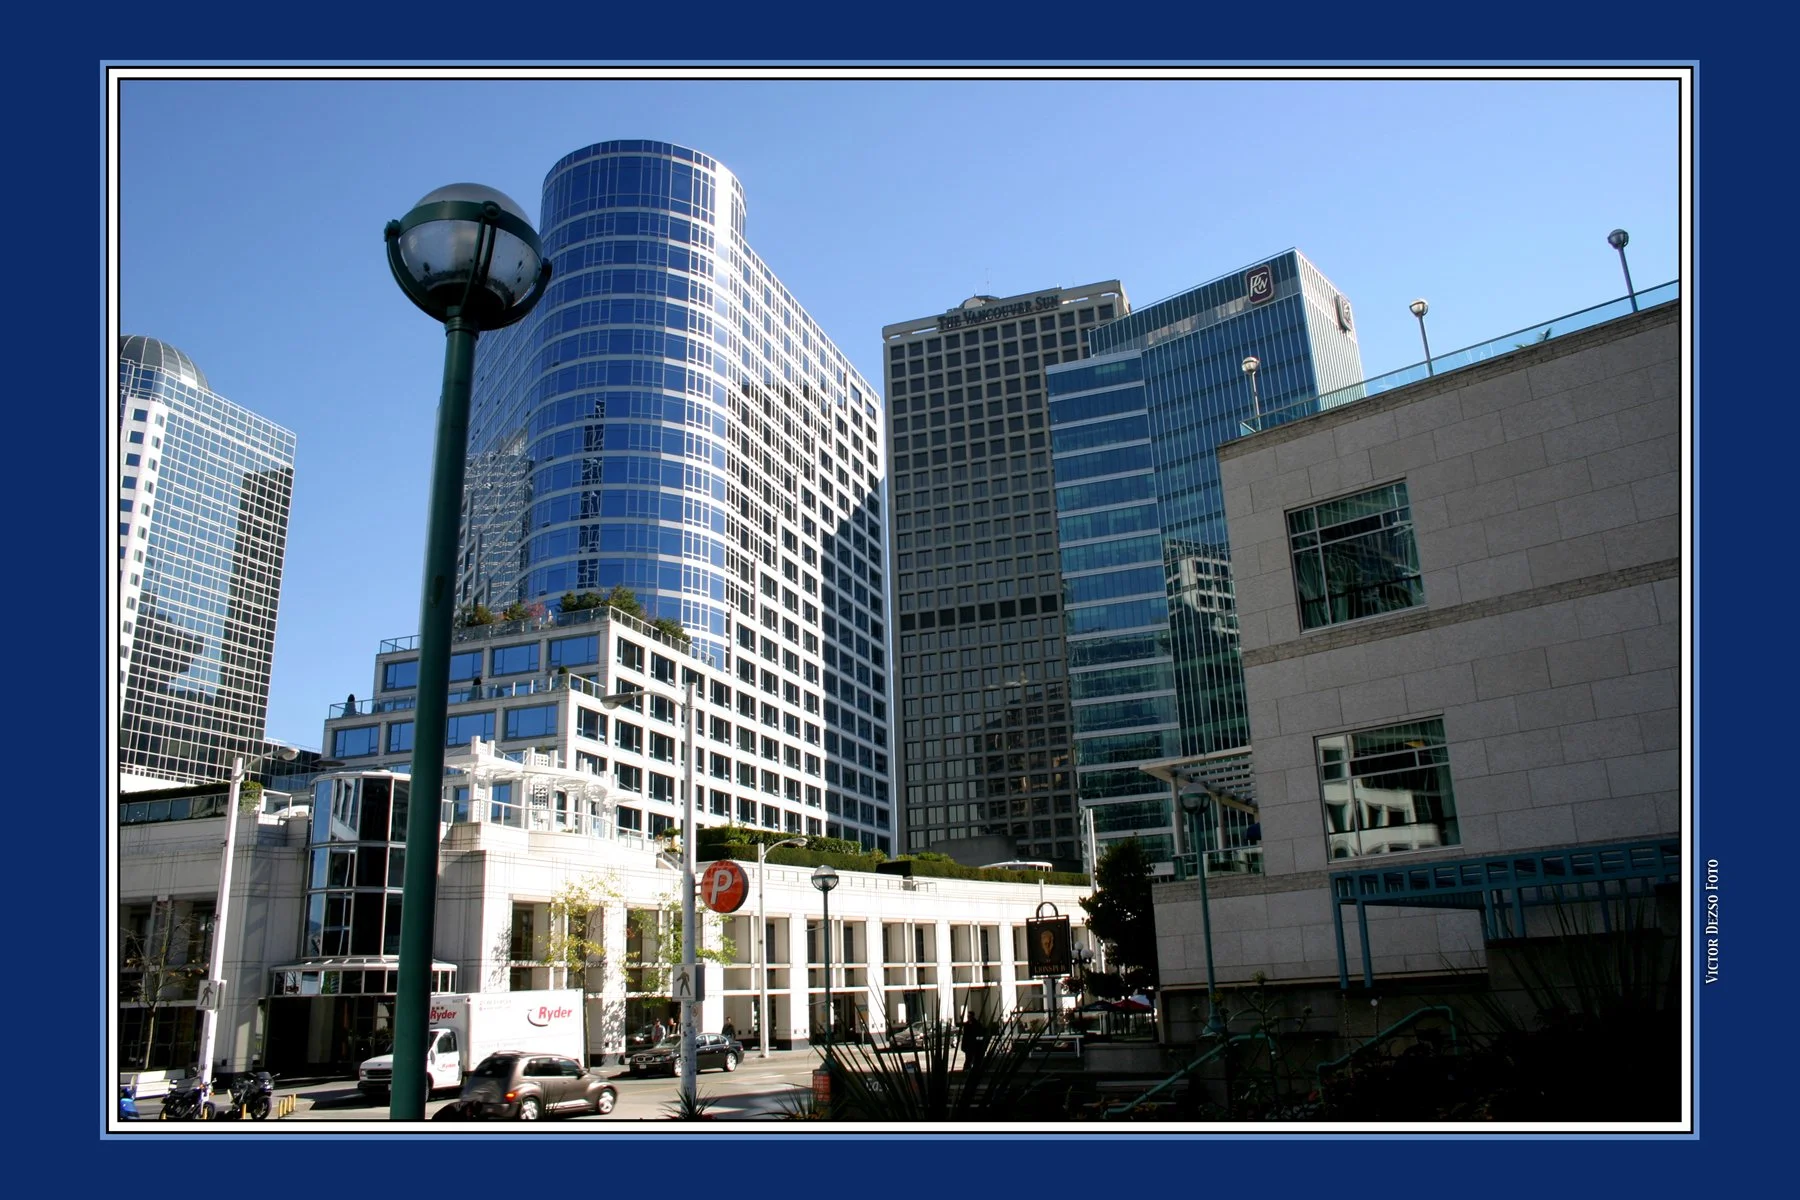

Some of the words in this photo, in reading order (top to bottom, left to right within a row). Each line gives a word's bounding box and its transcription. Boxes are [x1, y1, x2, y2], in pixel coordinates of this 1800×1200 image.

[937, 314, 960, 330] THE
[963, 302, 1033, 325] VANCOUVER
[1035, 295, 1059, 310] SUN
[711, 869, 733, 905] P
[430, 1009, 457, 1021] Ryder
[538, 1006, 573, 1022] Ryder
